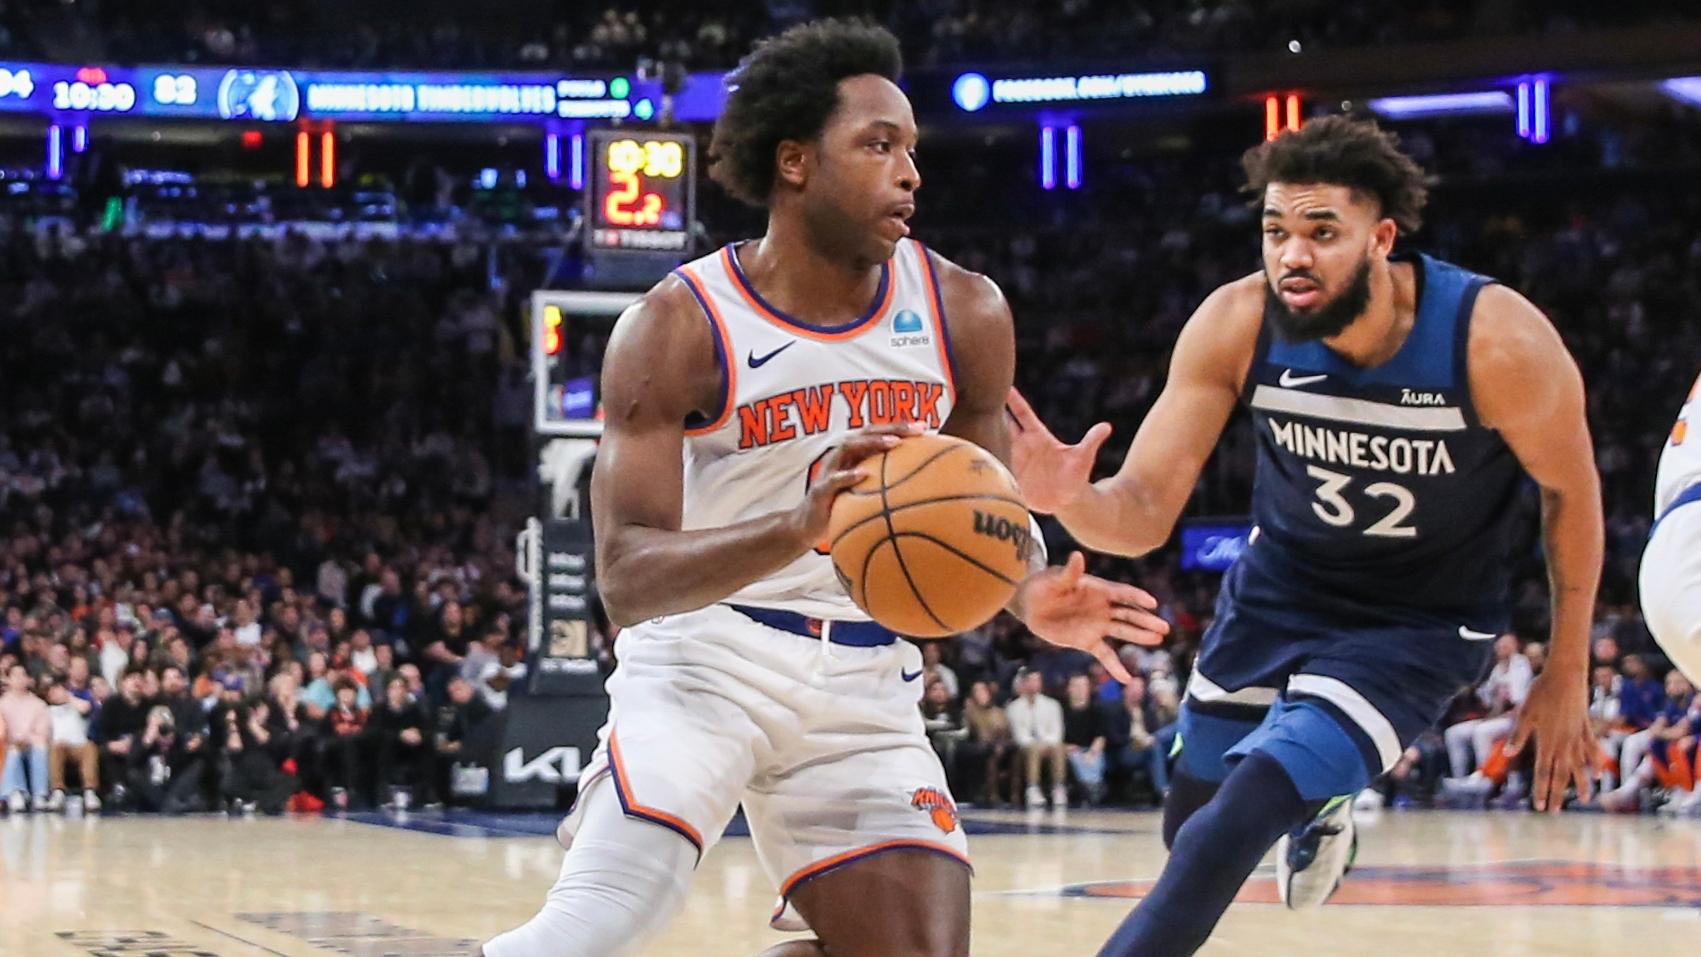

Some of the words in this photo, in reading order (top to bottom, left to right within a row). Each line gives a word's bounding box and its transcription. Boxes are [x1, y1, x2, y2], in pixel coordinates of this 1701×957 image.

[890, 336, 929, 347] sphere
[738, 383, 834, 449] NEW
[839, 379, 943, 429] YORK
[1268, 417, 1455, 475] MINNESOTA
[1306, 464, 1417, 537] 32
